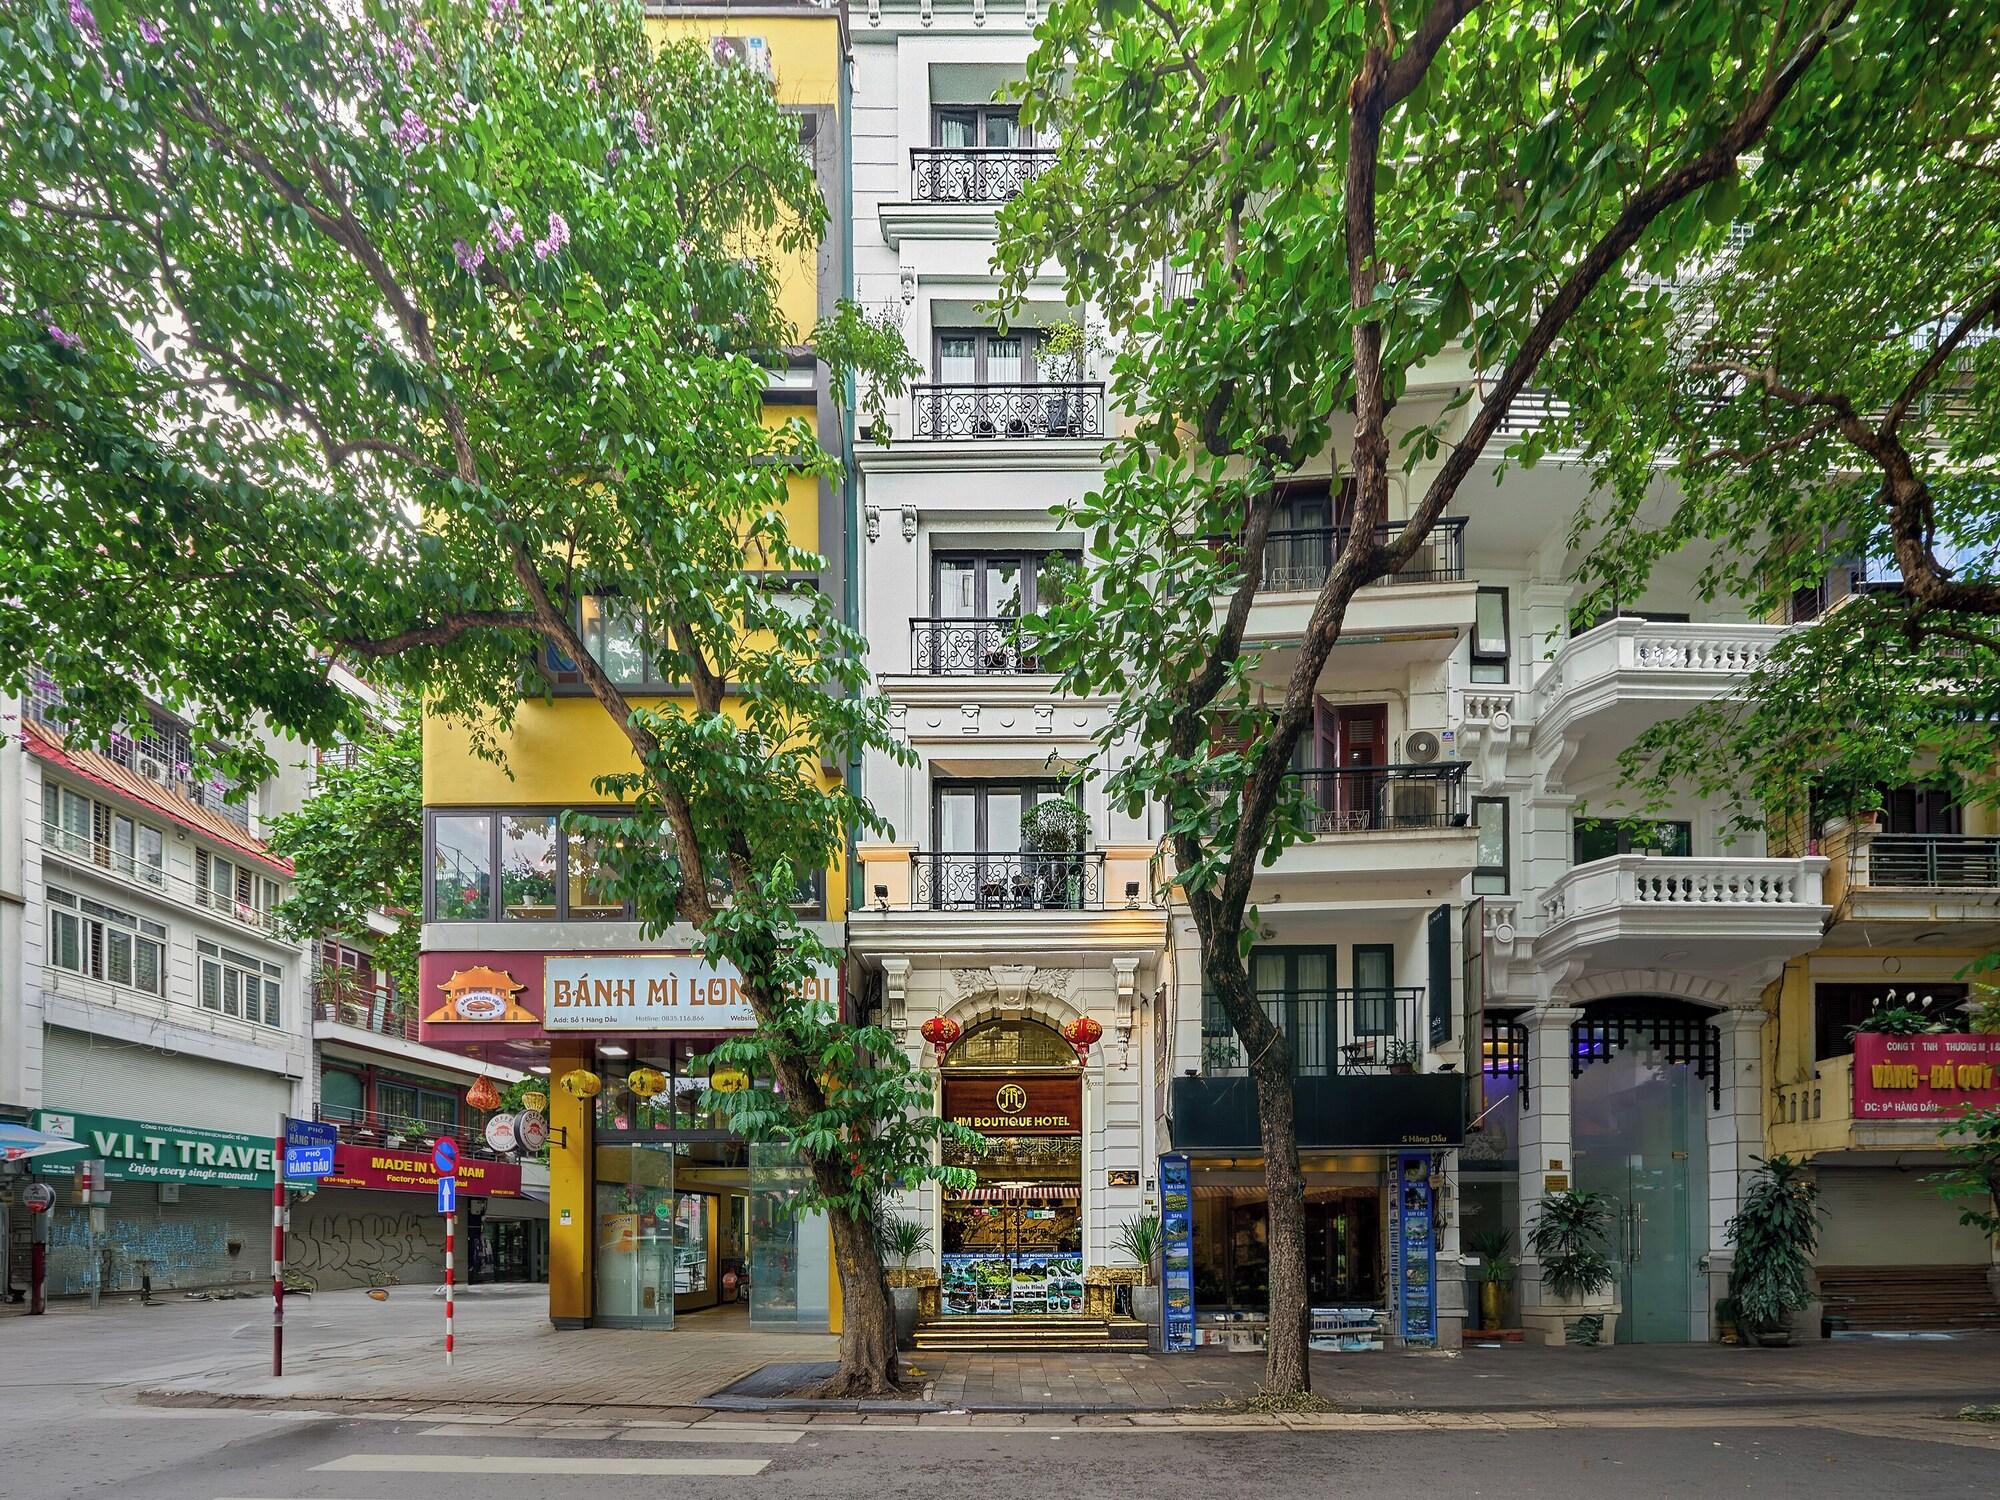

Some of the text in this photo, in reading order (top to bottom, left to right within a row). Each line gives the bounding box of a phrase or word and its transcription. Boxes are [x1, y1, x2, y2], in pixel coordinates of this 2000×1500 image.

[554, 972, 636, 1007] BÁNH
[646, 972, 678, 1006] MÌ
[690, 978, 748, 1006] LON
[554, 1016, 569, 1024] Add:
[1872, 1059, 1918, 1089] VÀNG
[1895, 1101, 1918, 1112] HÀNG
[954, 1116, 1070, 1128] HM BOUTIQUE HOTEL
[93, 1131, 166, 1160] V.I.T
[289, 1132, 308, 1146] HÀNG
[1408, 1136, 1430, 1144] Hàng
[128, 1162, 158, 1176] Enjoy
[160, 1168, 186, 1178] every
[188, 1168, 216, 1179] single
[290, 1160, 311, 1172] HÀNG
[372, 1157, 413, 1172] MADE
[414, 1162, 427, 1174] IN
[386, 1174, 416, 1184] Factory
